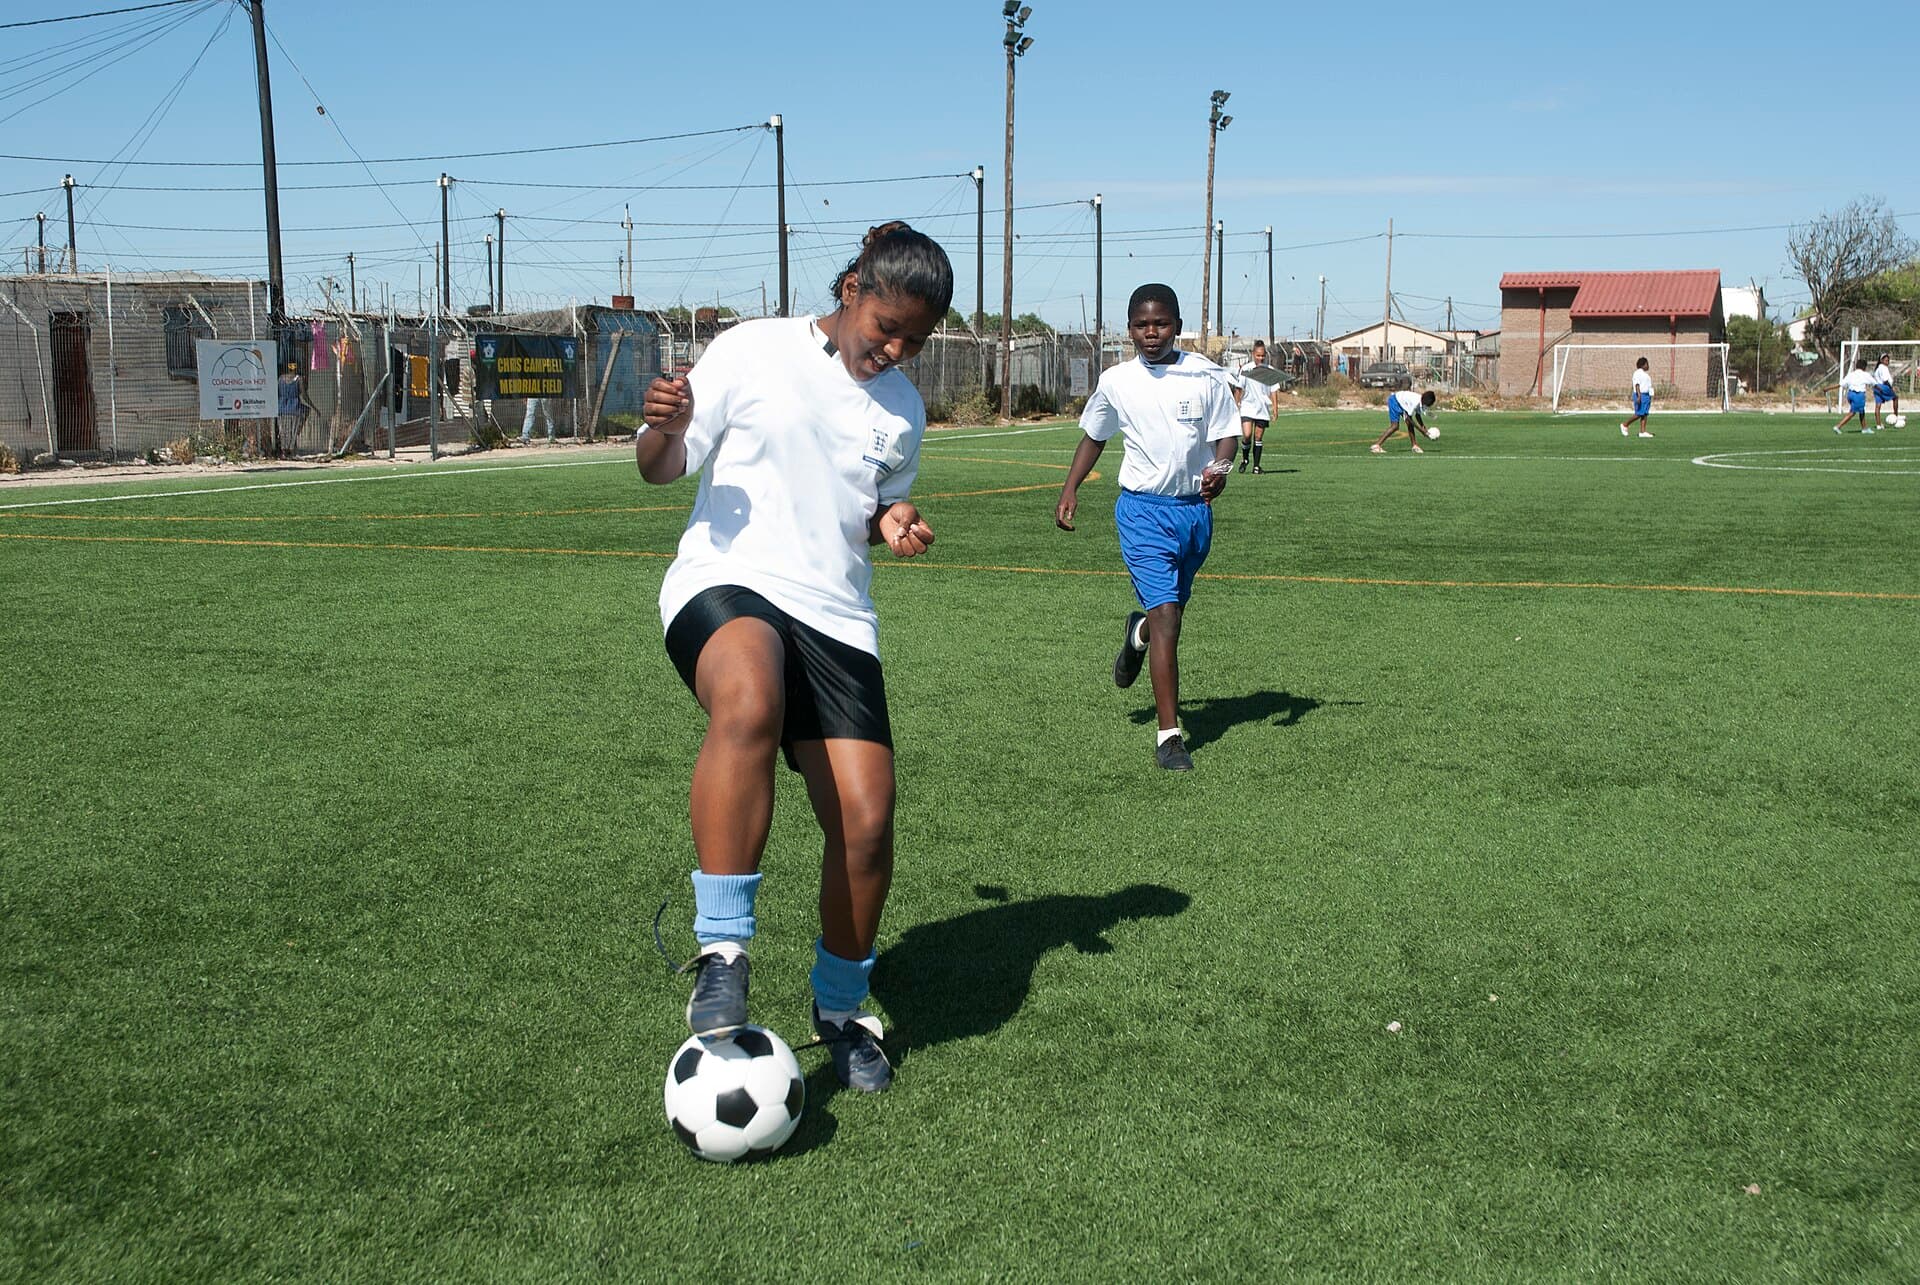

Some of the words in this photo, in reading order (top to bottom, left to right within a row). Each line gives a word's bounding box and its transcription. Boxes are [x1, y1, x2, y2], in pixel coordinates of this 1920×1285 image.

[497, 357, 522, 373] CHRIS
[523, 357, 564, 373] CAMPBELL
[212, 378, 243, 386] COACHING
[499, 378, 541, 394] MEMORIAL
[542, 378, 563, 393] FIELD
